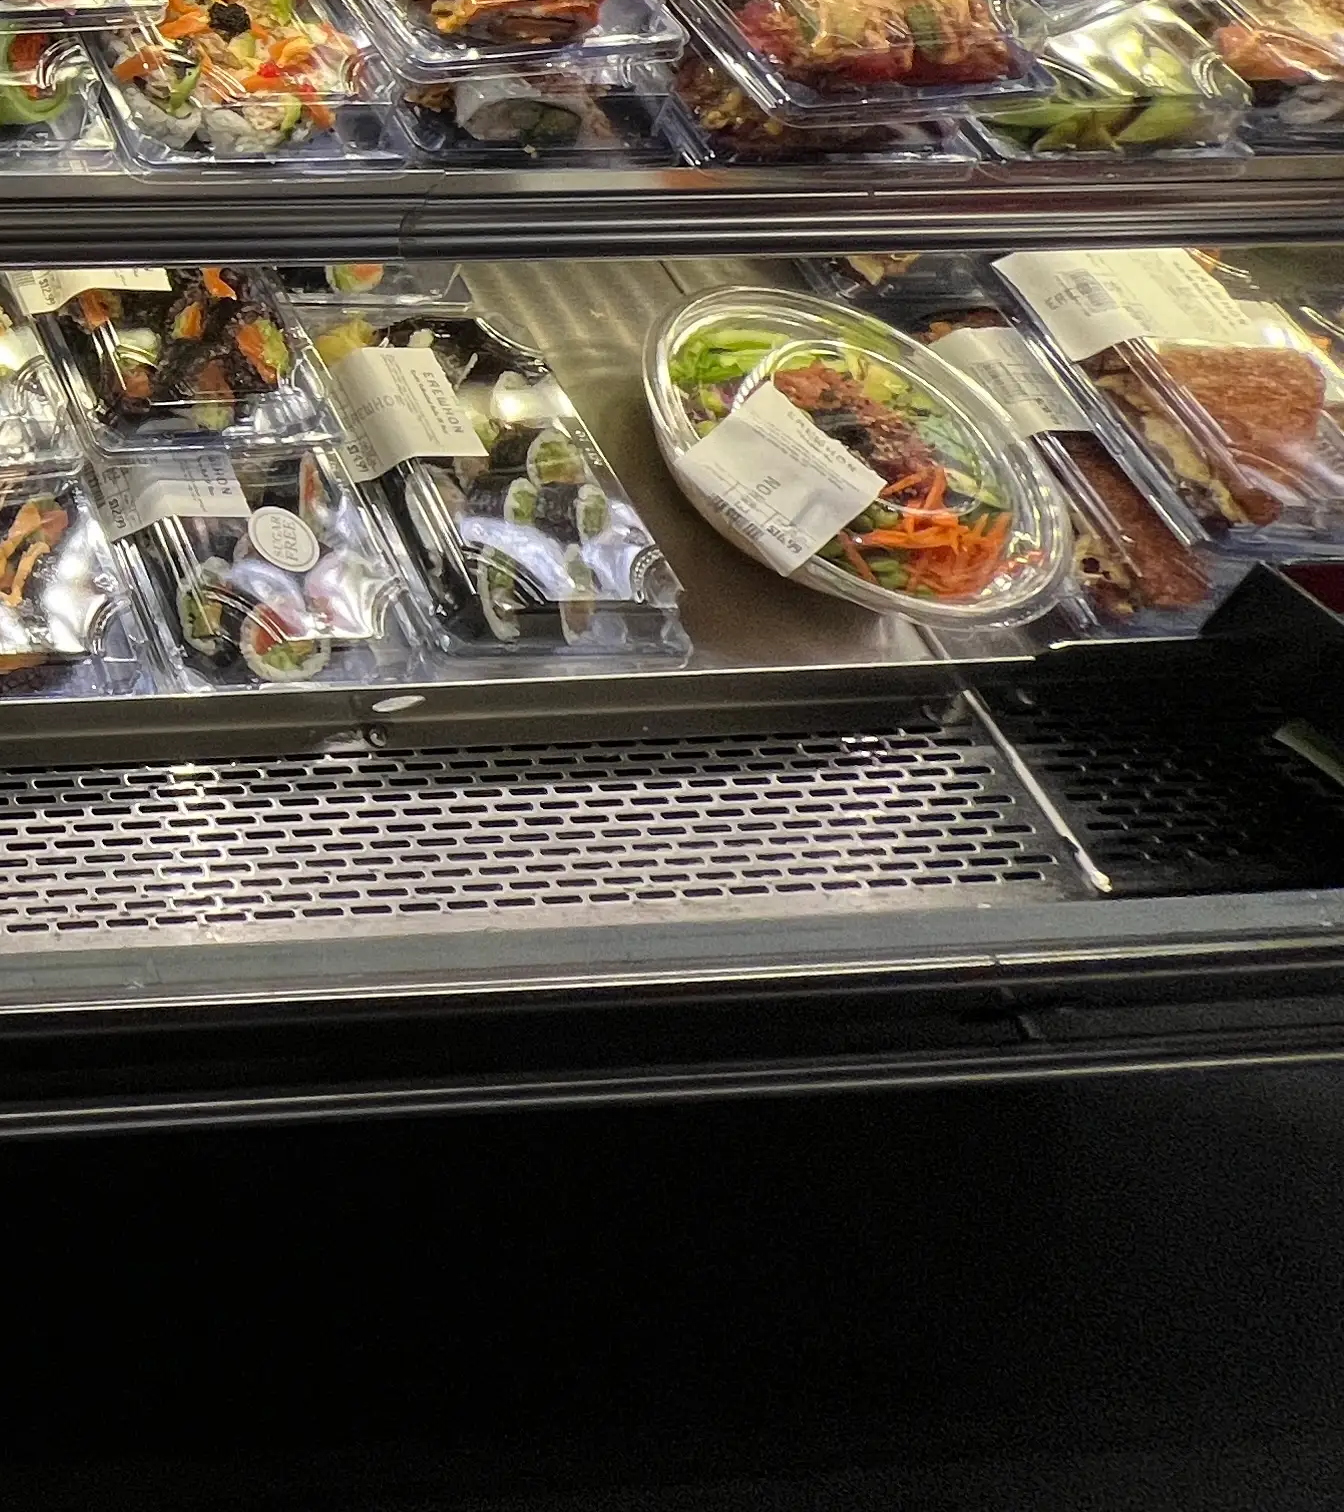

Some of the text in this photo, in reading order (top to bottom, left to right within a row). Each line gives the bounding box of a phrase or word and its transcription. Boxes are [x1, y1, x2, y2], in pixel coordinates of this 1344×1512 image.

[423, 371, 464, 433] EREWHON
[270, 516, 283, 559] SUGAR
[282, 518, 299, 562] FREE
